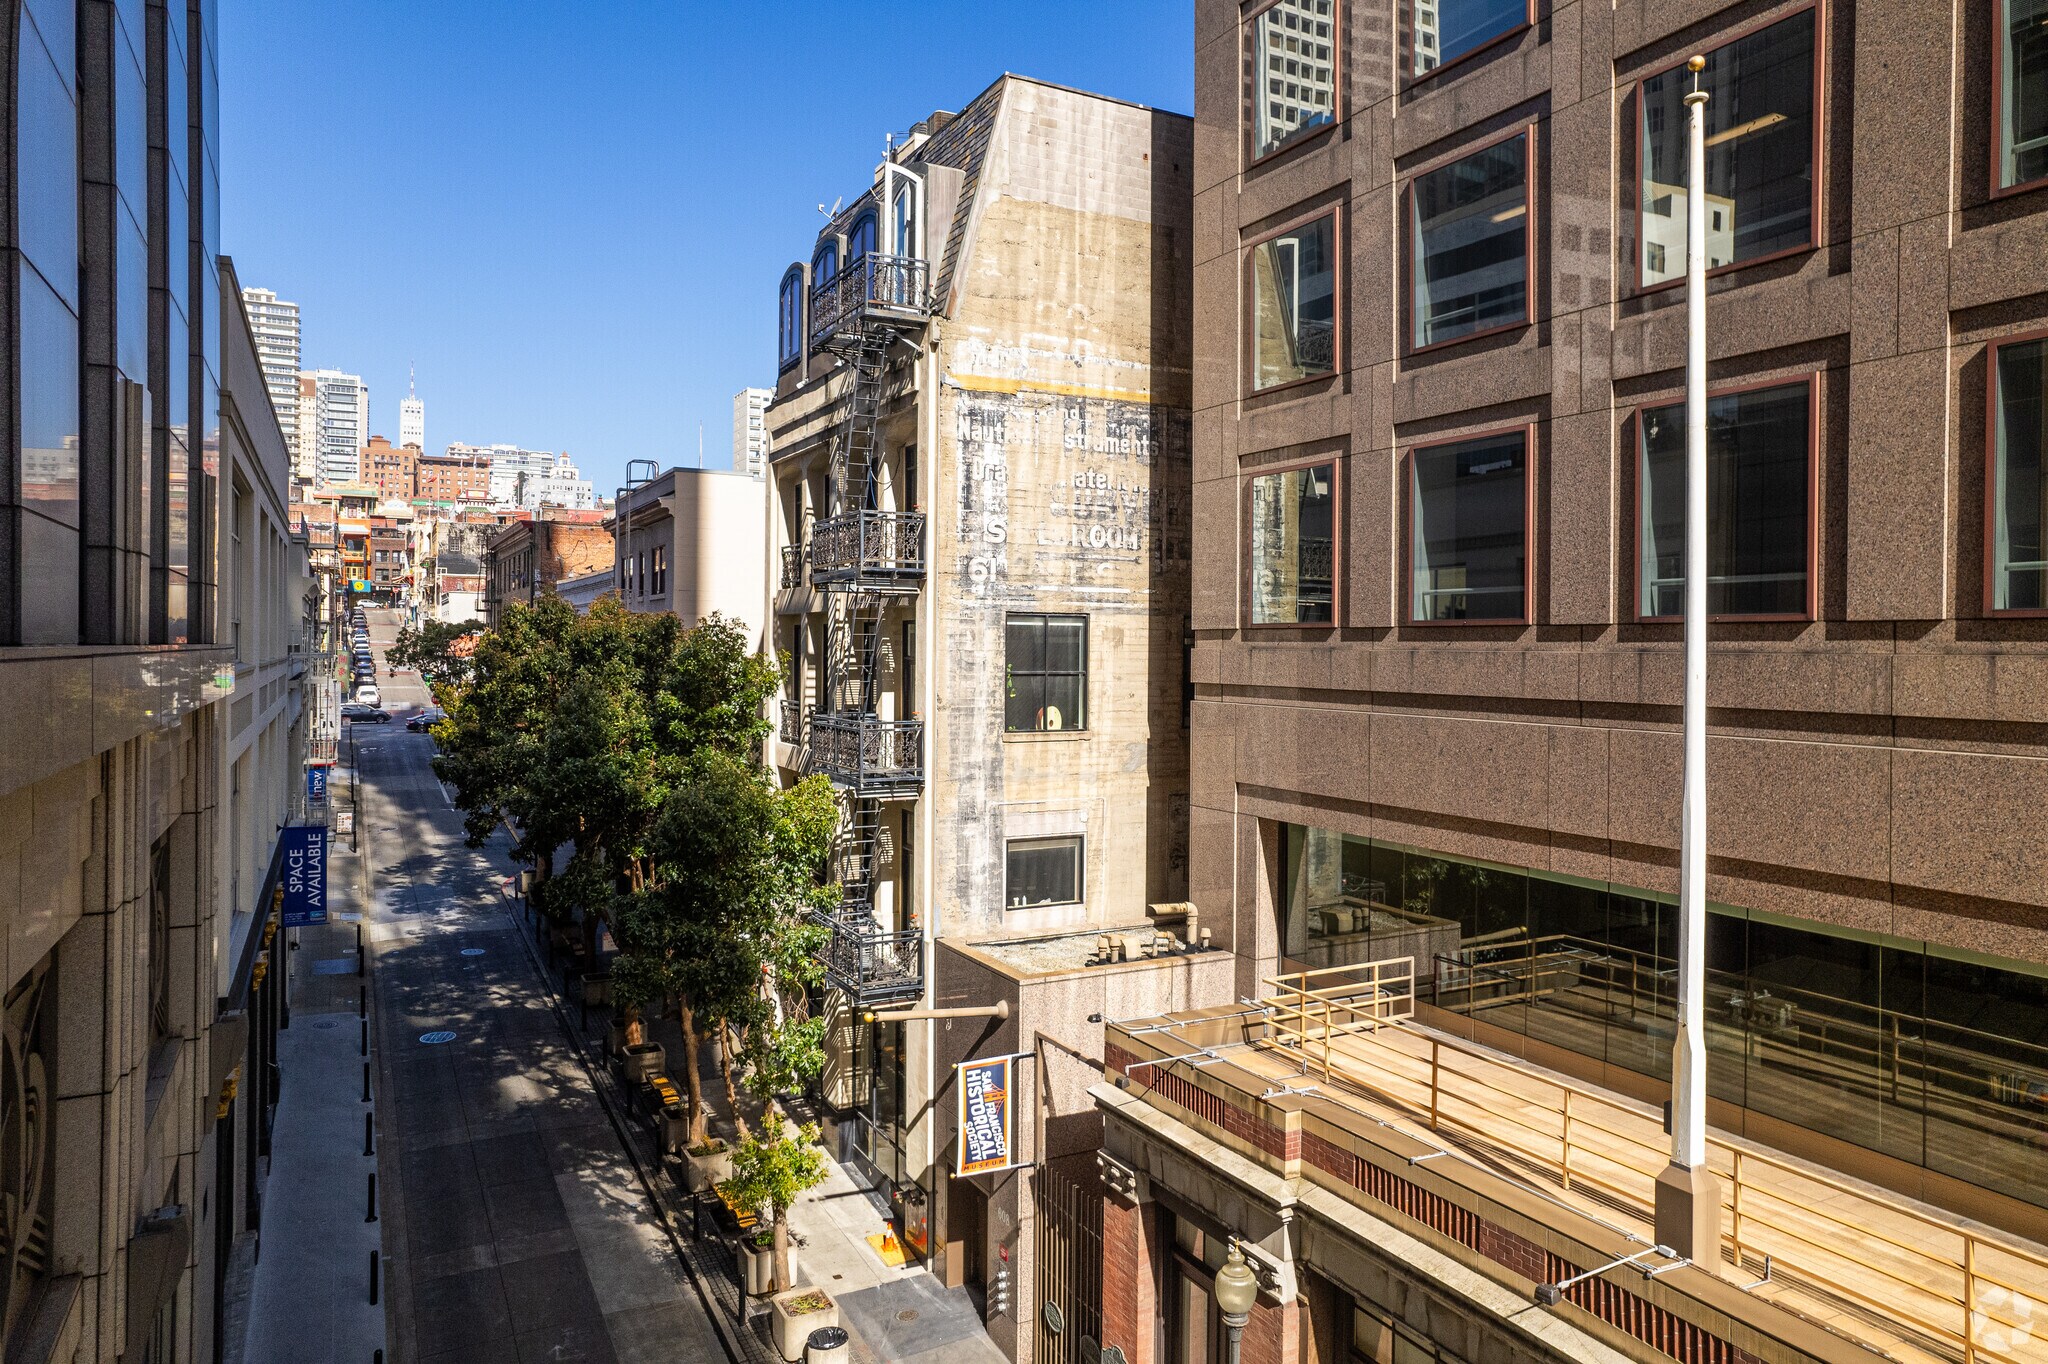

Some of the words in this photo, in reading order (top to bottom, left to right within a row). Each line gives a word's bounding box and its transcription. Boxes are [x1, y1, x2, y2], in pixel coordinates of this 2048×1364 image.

[289, 848, 304, 893] SPACE
[307, 833, 322, 907] AVAILABLE
[981, 1070, 993, 1093] SAN
[966, 1069, 998, 1160] HISTORICAL
[984, 1101, 1007, 1157] FRANCISCO
[963, 1120, 982, 1161] SOCIETY
[963, 1159, 1006, 1172] MUSEUM
